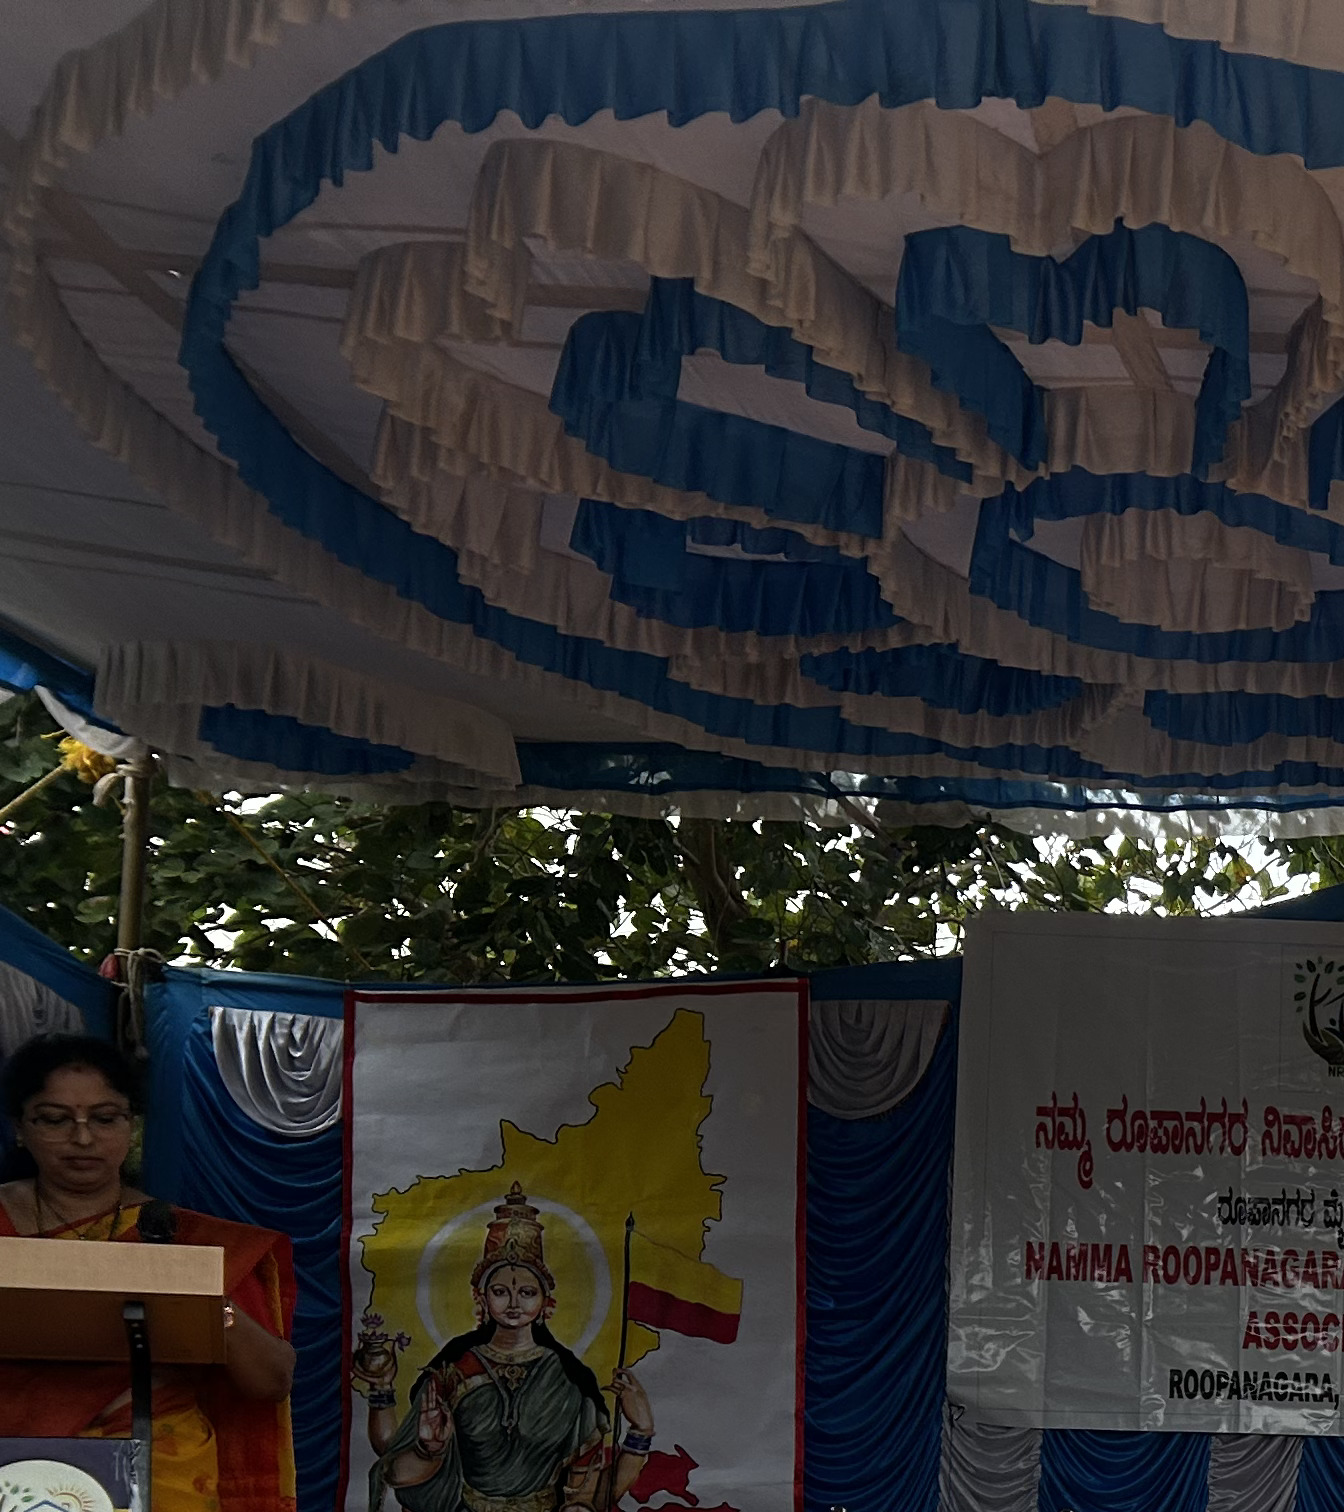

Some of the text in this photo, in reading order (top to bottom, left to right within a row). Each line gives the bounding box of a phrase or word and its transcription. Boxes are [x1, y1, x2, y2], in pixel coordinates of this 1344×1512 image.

[1035, 1091, 1094, 1189] ನಮ್ಮ
[1105, 1094, 1249, 1156] ರೂಪಾನಗರ
[1217, 1186, 1315, 1228] ರೂಪಾನಗರ
[1025, 1241, 1134, 1283] NAMMA
[1168, 1368, 1341, 1411] ROOPANAGARA,
